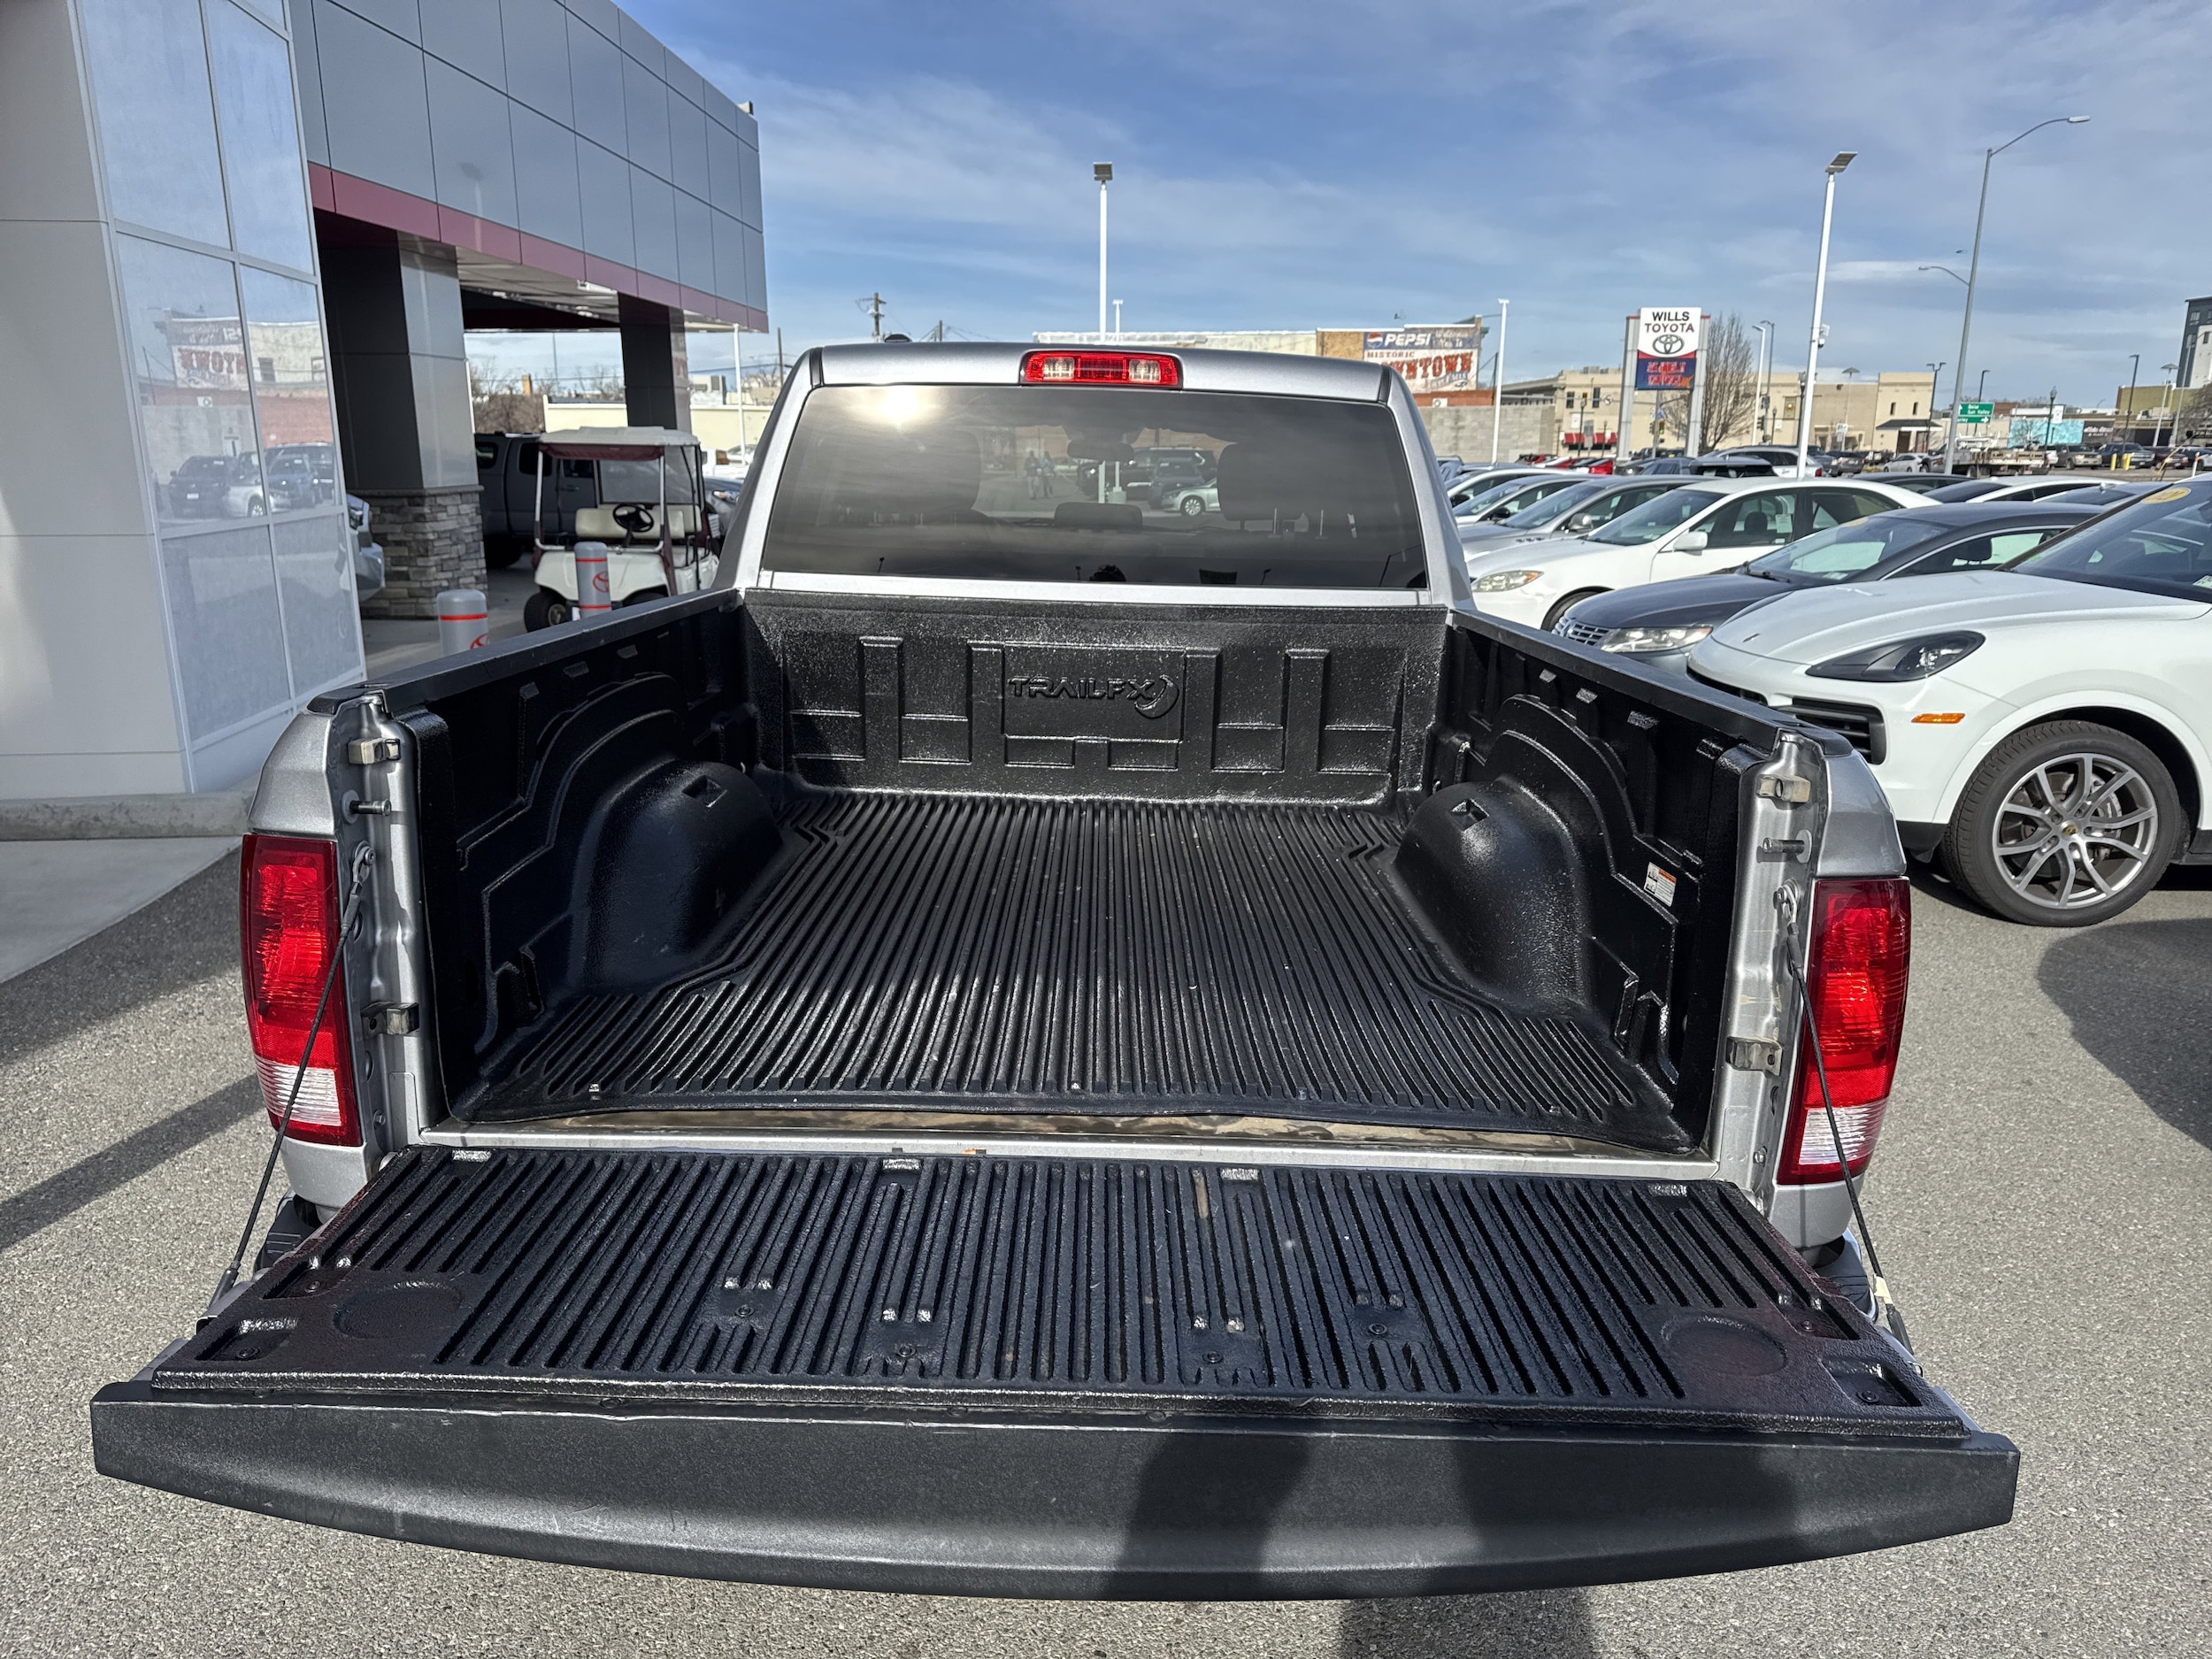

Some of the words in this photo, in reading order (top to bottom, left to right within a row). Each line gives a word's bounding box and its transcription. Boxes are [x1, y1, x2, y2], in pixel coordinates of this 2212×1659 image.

[1652, 311, 1690, 322] WILLS
[1644, 323, 1694, 333] TOYOTA
[1384, 333, 1431, 347] PEPSI
[1382, 351, 1473, 380] WNTOWN
[1008, 674, 1156, 701] TRAILFX
